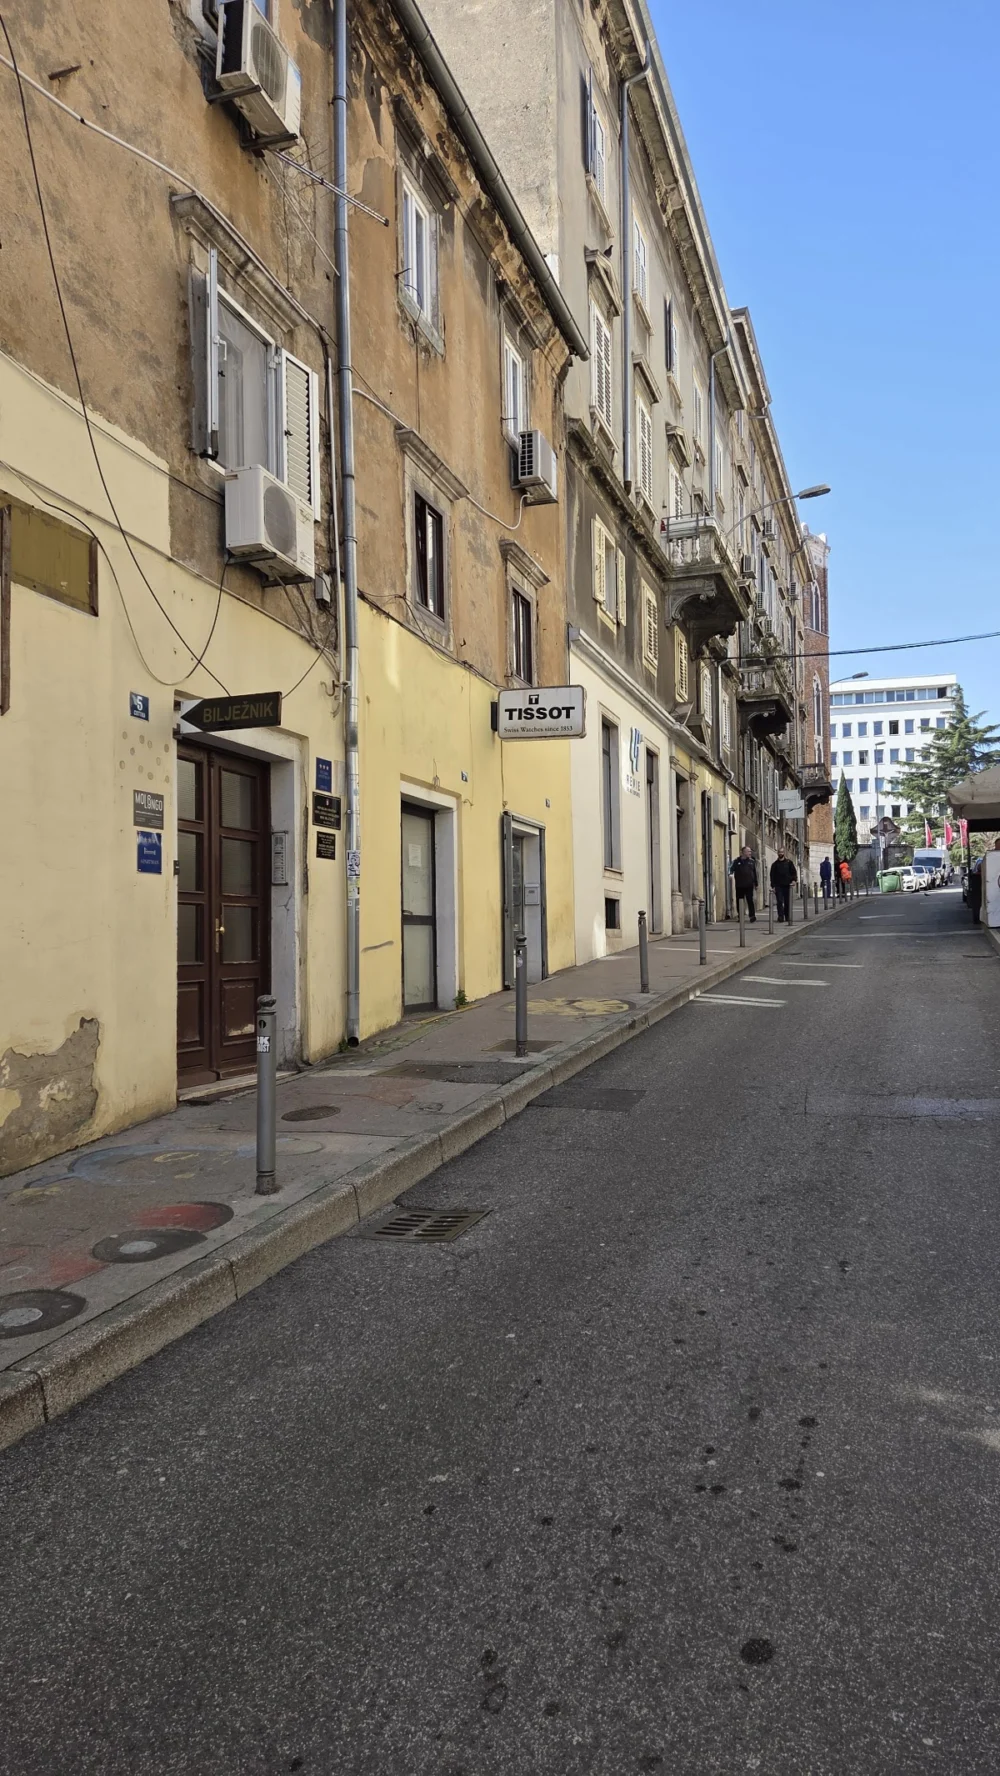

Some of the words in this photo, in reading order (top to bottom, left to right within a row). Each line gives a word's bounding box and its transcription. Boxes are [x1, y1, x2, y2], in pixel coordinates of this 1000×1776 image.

[529, 695, 539, 704] T
[203, 701, 273, 723] BILJEŽNIK
[504, 706, 575, 721] TISSOT
